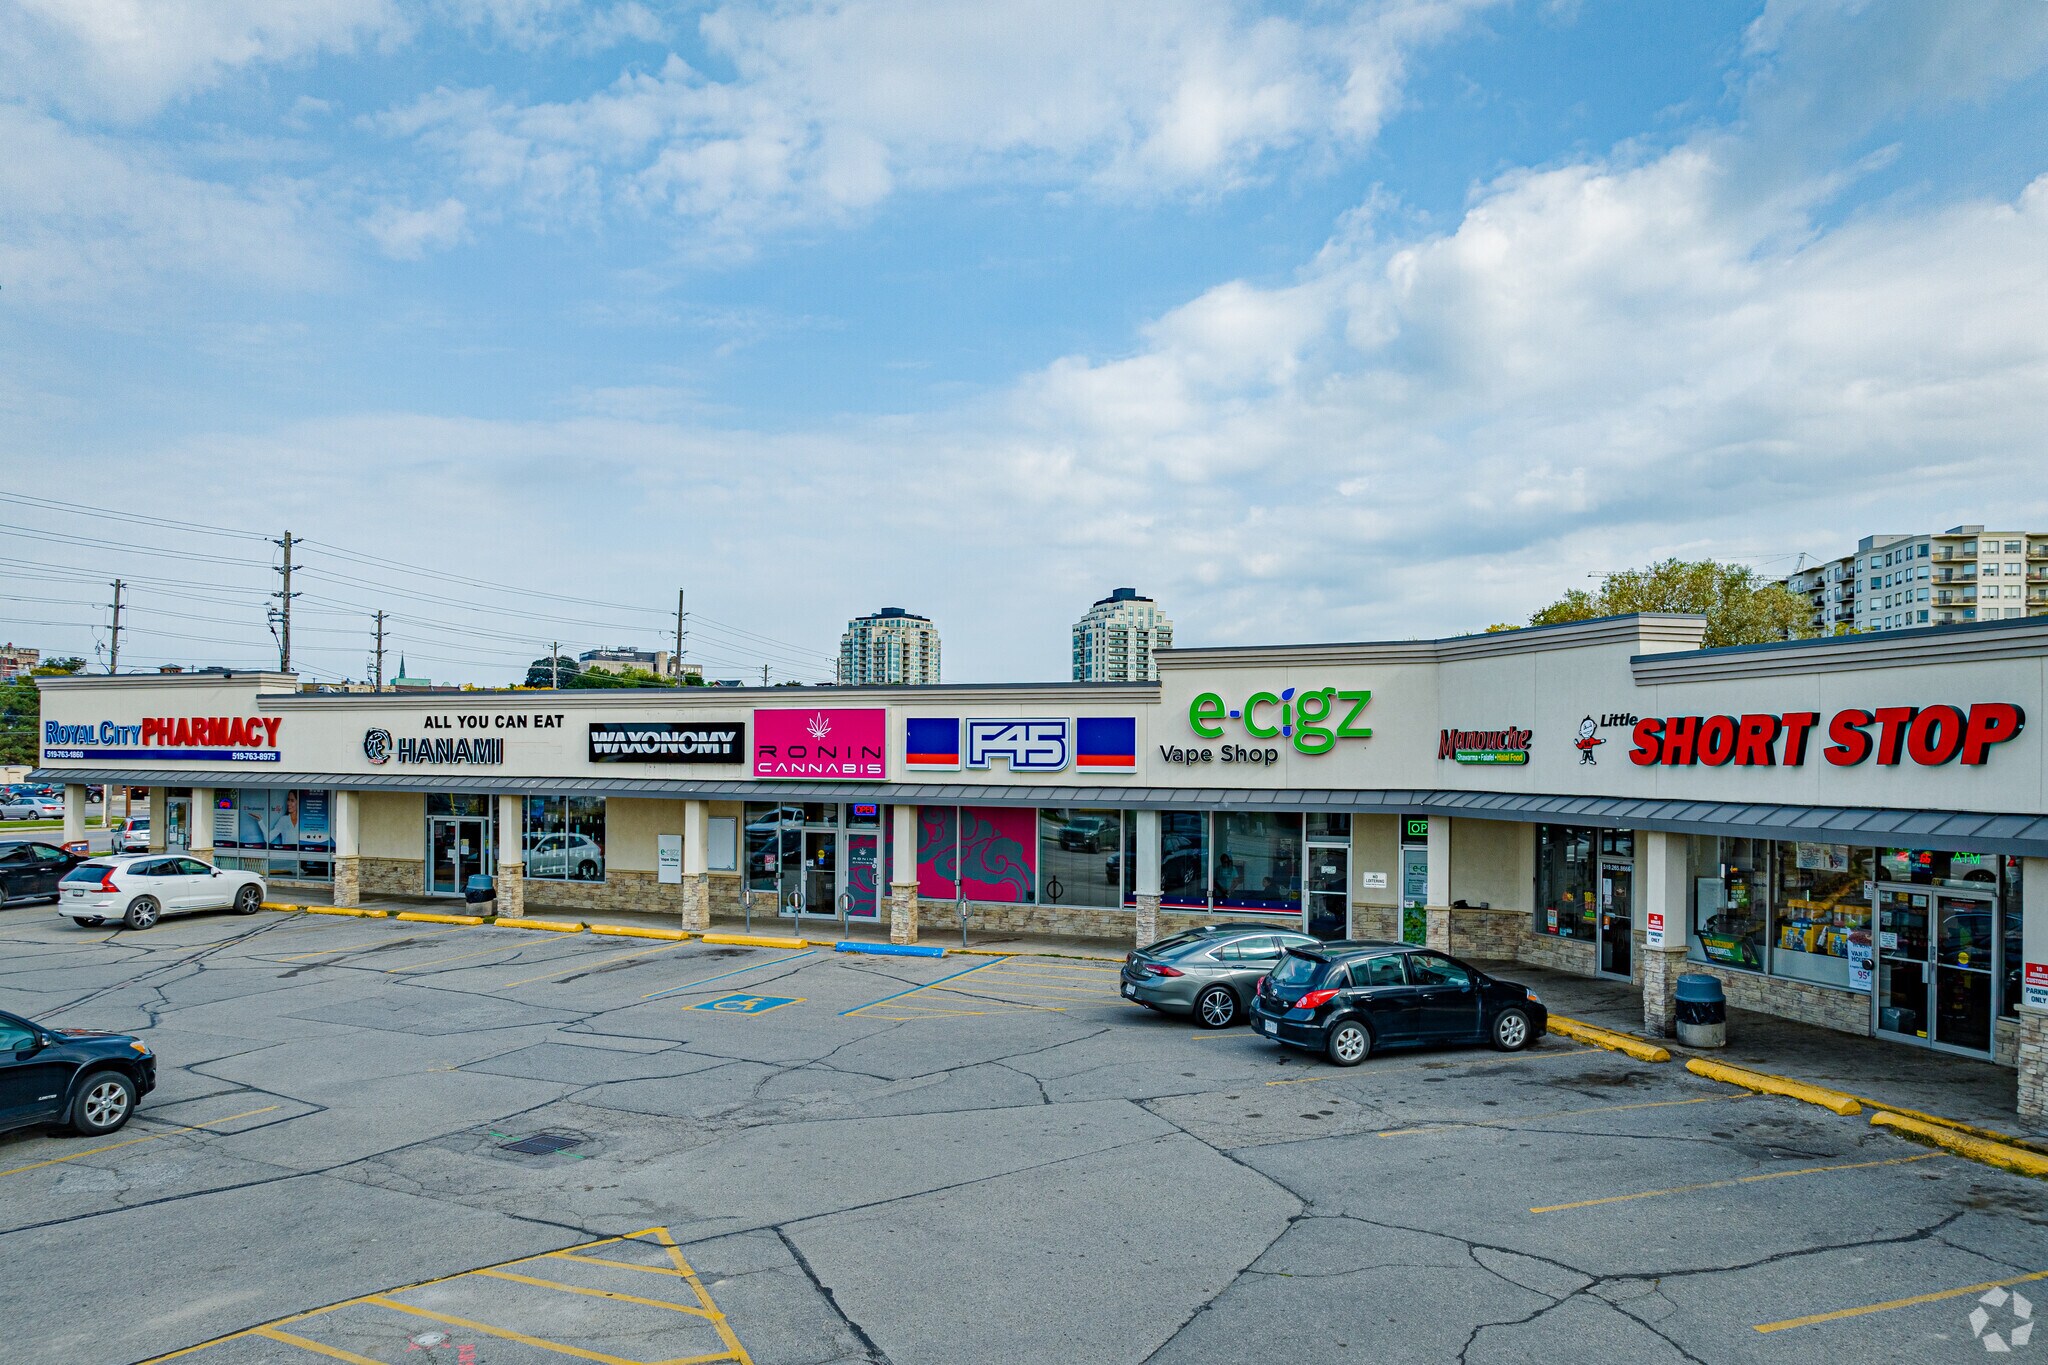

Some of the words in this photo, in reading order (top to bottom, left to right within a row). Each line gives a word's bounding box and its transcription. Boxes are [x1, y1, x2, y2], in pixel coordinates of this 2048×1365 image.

[424, 716, 451, 728] ALL
[457, 715, 489, 728] YOU
[495, 715, 528, 728] CAN
[534, 714, 564, 728] EAT
[1189, 687, 1373, 755] e-cigz
[142, 717, 282, 747] PHARMACY
[1600, 712, 1638, 728] Little
[1629, 712, 1820, 767] SHORT
[1824, 703, 2026, 766] STOP
[591, 731, 736, 754] WAXONOMY
[972, 724, 1063, 764] F45
[1438, 726, 1532, 760] Manouche
[232, 752, 276, 760] 519-763-8975
[398, 738, 504, 764] HANAMI
[759, 745, 881, 759] RONIN
[1160, 745, 1212, 766] Vape
[1220, 744, 1279, 766] Shop
[1510, 753, 1523, 762] Food
[758, 762, 882, 774] CANNABIS
[1411, 823, 1427, 833] OP
[1953, 851, 1981, 865] ATM
[2026, 987, 2048, 996] PARKIN
[2031, 996, 2047, 1004] ONLY
